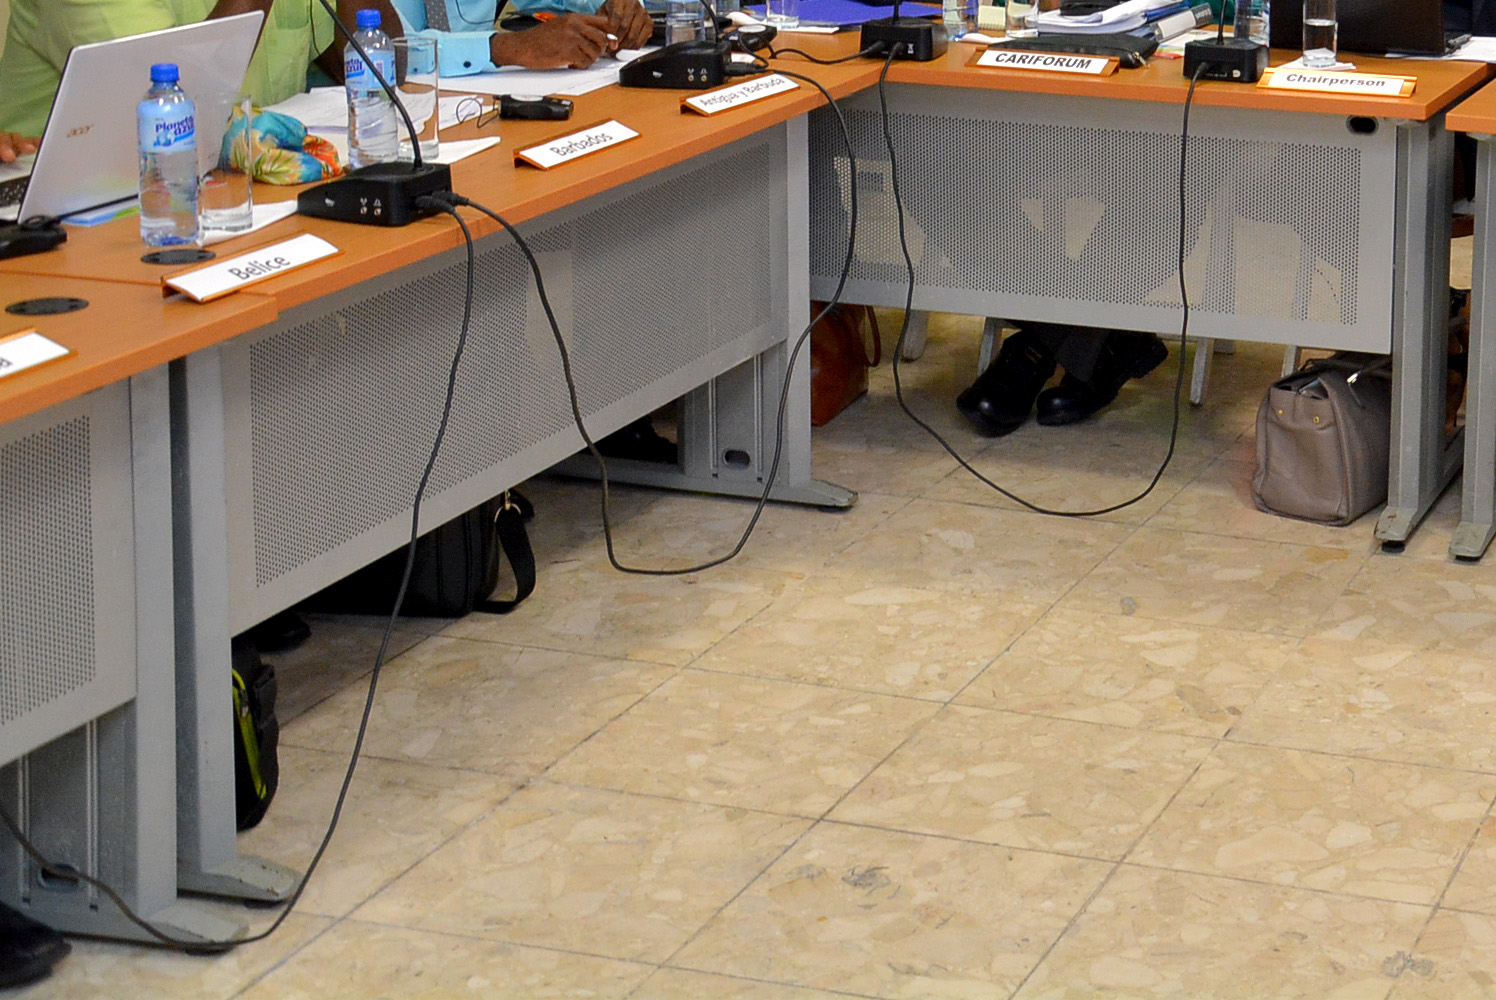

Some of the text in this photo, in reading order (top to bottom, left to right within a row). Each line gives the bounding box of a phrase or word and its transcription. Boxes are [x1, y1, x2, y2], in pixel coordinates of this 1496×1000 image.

[995, 53, 1092, 69] CARIFORUM
[1286, 74, 1386, 86] Chairperson
[549, 133, 613, 156] Barbados
[229, 256, 290, 280] Belice
